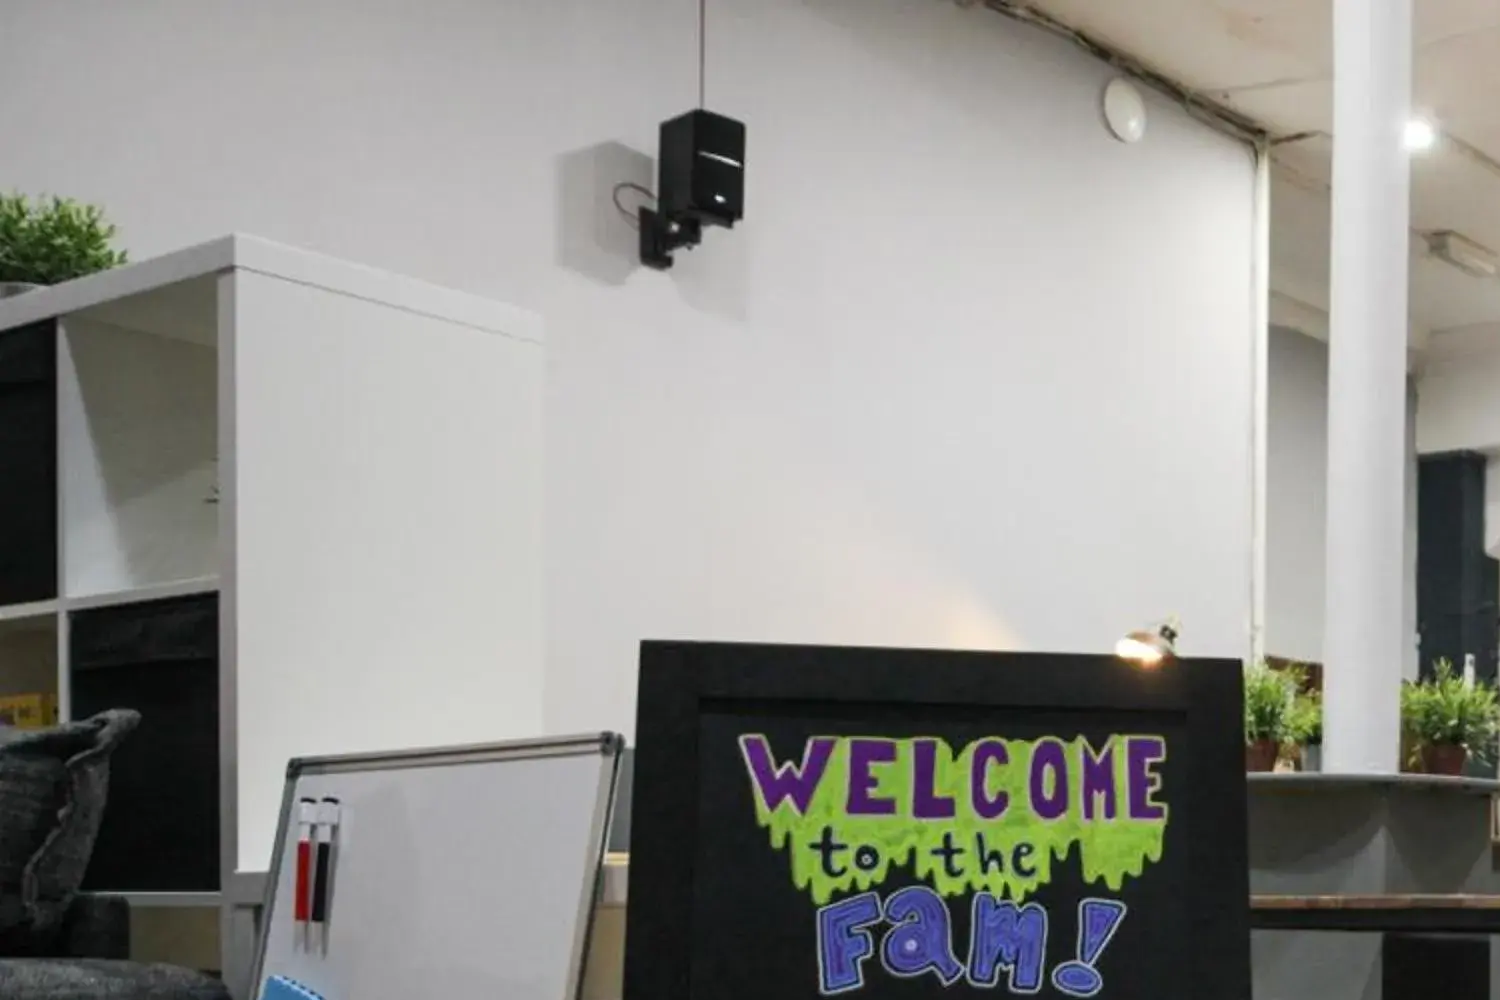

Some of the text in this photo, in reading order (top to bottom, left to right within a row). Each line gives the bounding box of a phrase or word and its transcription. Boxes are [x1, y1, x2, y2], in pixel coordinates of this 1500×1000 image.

[738, 732, 1168, 823] WELCOME
[810, 826, 1037, 878] to the
